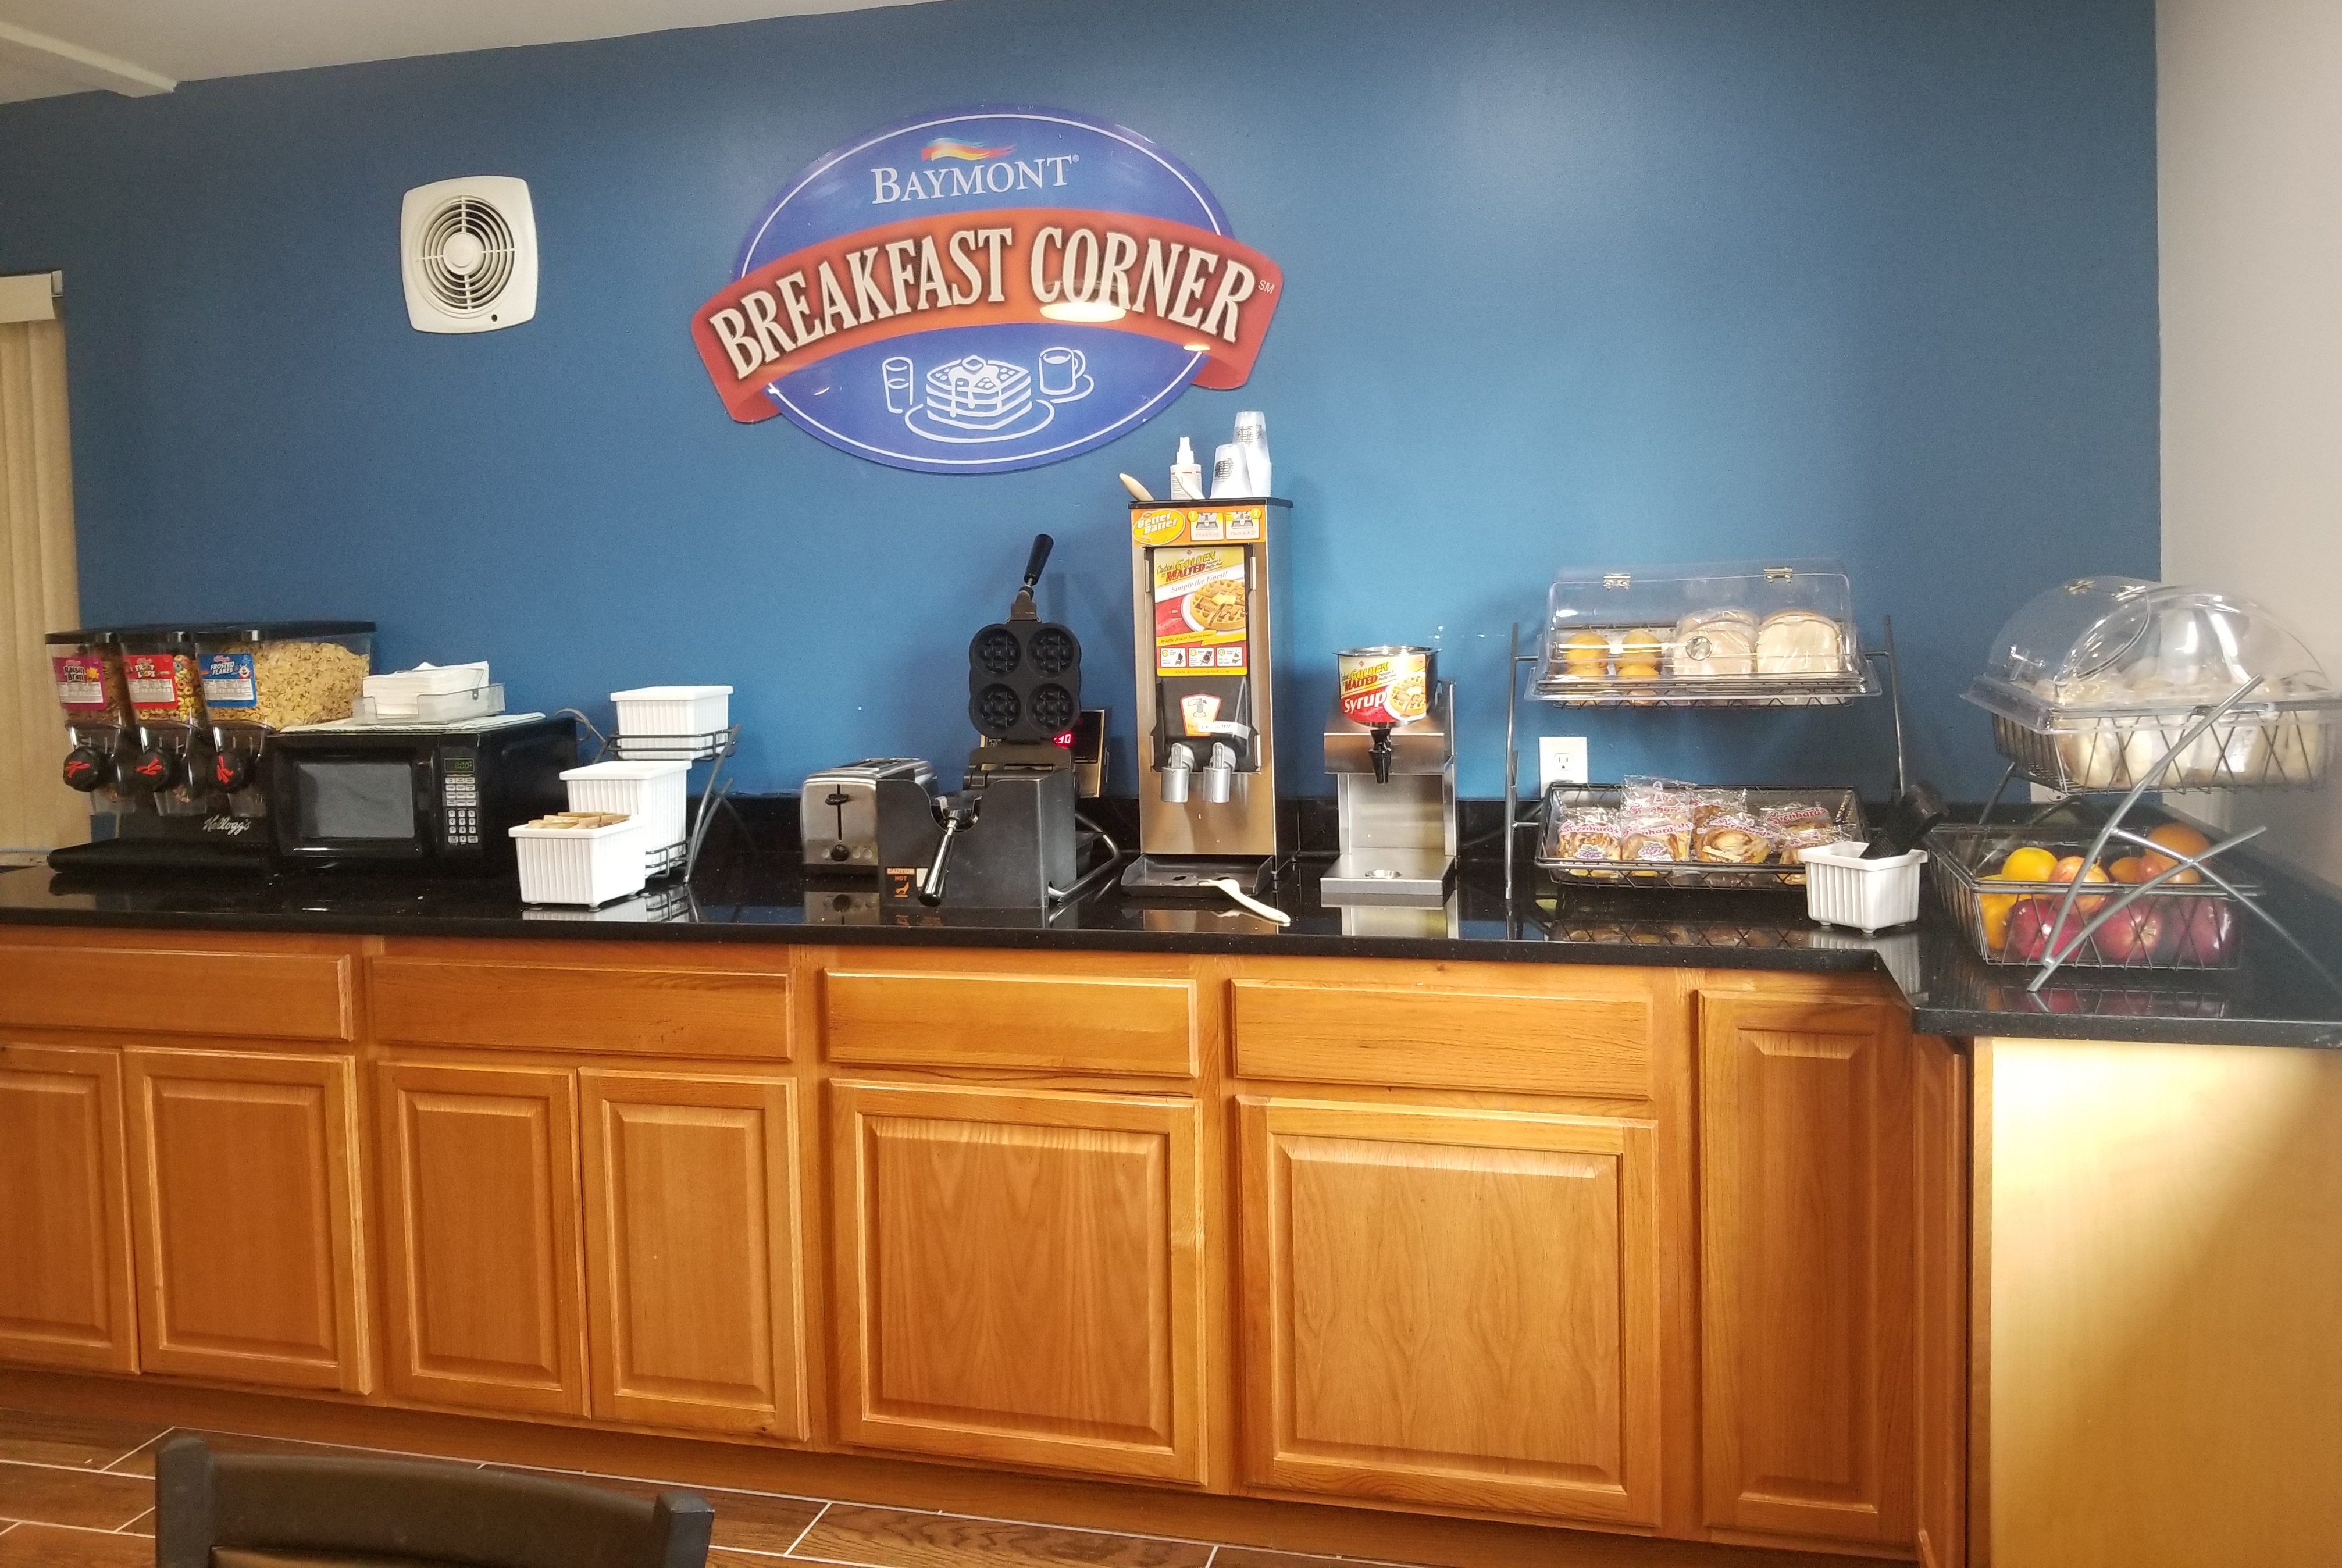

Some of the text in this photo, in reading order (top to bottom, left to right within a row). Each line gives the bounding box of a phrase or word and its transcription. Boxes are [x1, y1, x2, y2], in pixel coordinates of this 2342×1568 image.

[871, 154, 1072, 204] BAYMONT
[709, 227, 1256, 380] BREAKFAST CORNER
[1136, 512, 1172, 529] Better
[1143, 518, 1178, 534] Batter
[1175, 550, 1216, 571] GOLDEN
[1165, 563, 1206, 583] MALTED
[1171, 571, 1228, 593] Simply the Finest!
[65, 667, 85, 675] Raisin
[210, 661, 235, 671] FROSTED
[212, 668, 233, 676] FLAKES
[1350, 662, 1389, 680] GOLDEN
[1344, 675, 1378, 692] MALTED
[1344, 691, 1386, 714] Syrup
[1766, 807, 1828, 824] Svenhard's
[202, 814, 252, 836] Kellogg's
